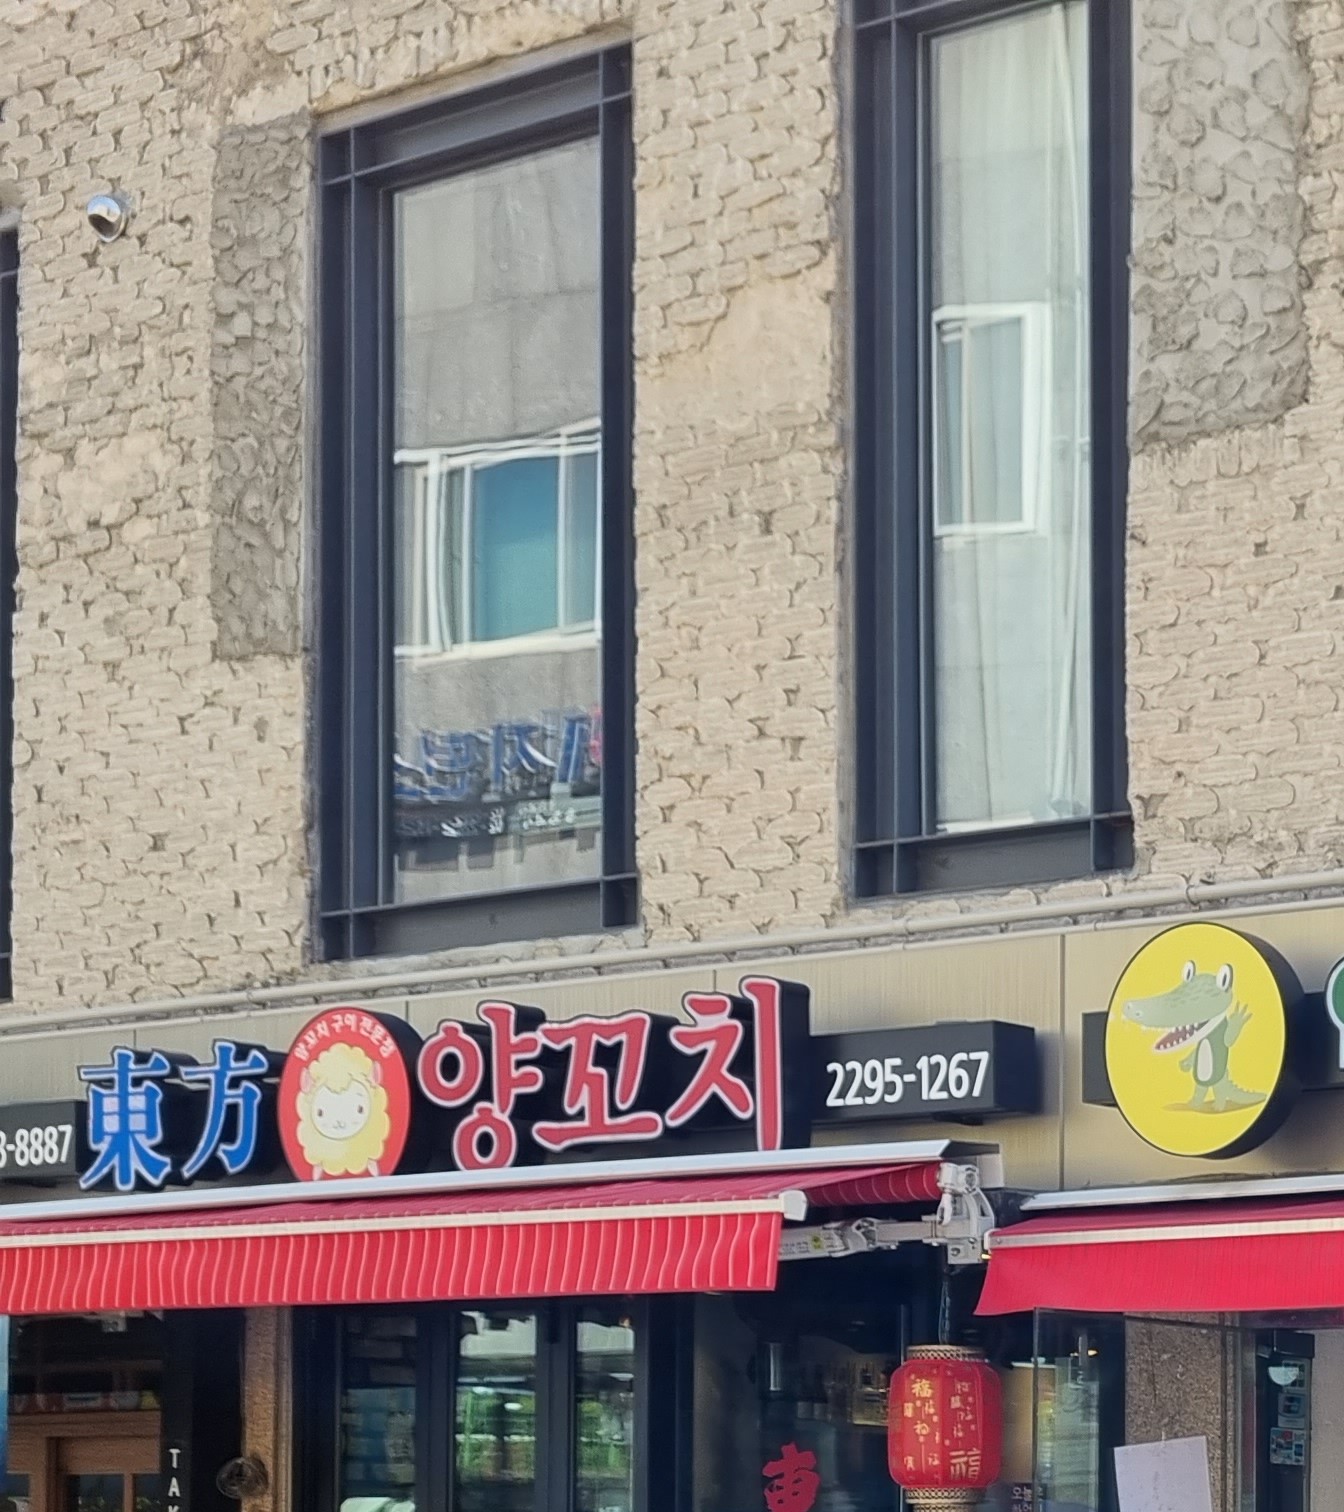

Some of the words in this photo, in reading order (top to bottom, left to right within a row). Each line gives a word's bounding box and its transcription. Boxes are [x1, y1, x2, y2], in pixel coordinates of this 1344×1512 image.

[331, 1012, 358, 1033] 구이
[78, 1046, 268, 1190] 東方
[417, 974, 787, 1173] 양꼬치
[825, 1049, 990, 1108] 2295-1267
